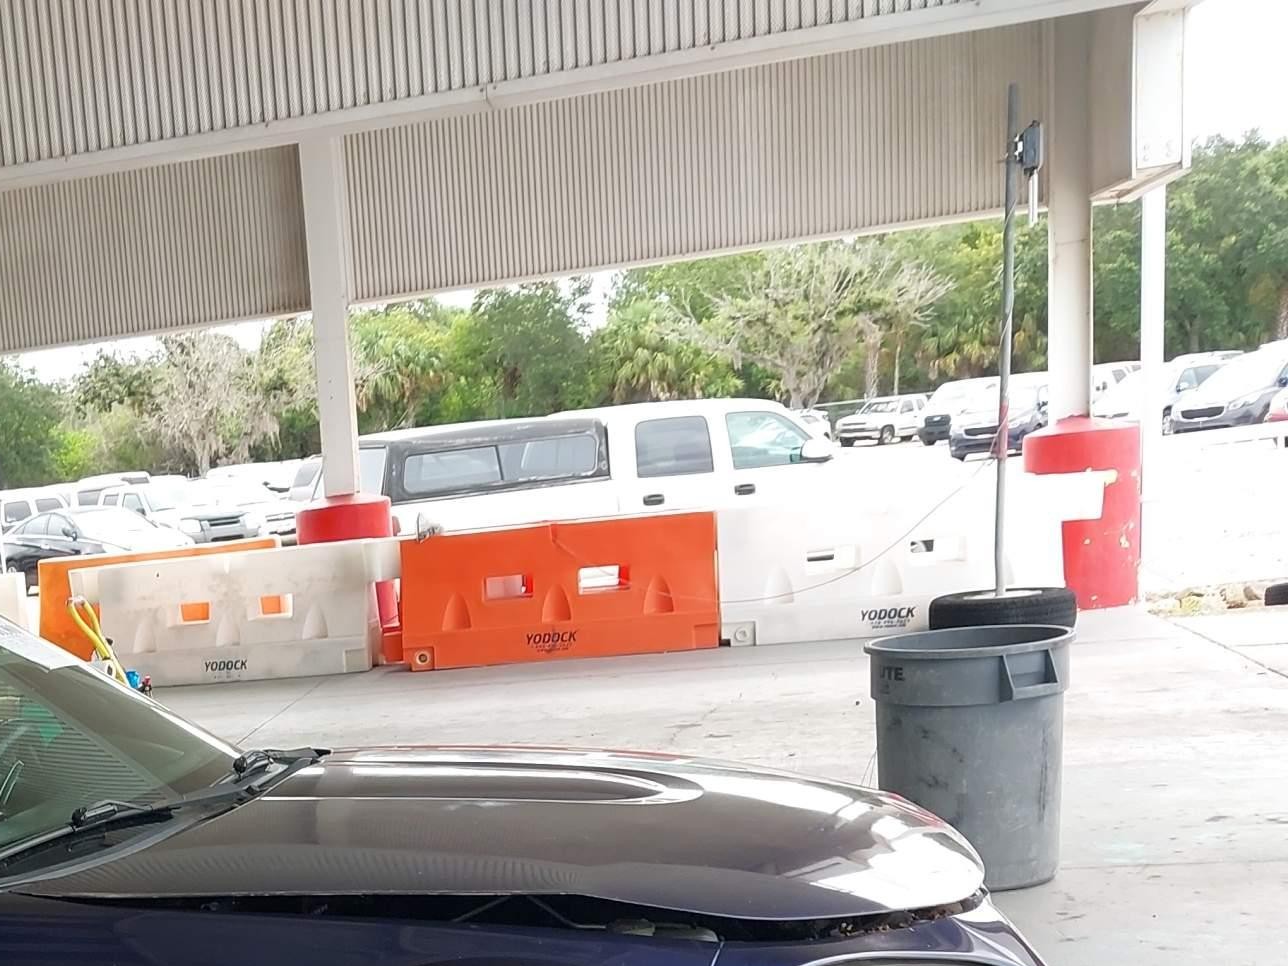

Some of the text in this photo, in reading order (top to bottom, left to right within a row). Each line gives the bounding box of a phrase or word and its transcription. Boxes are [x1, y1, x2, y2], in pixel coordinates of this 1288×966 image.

[861, 607, 916, 621] YODOCK
[526, 631, 577, 645] YODOCK
[205, 659, 247, 672] YODOCK
